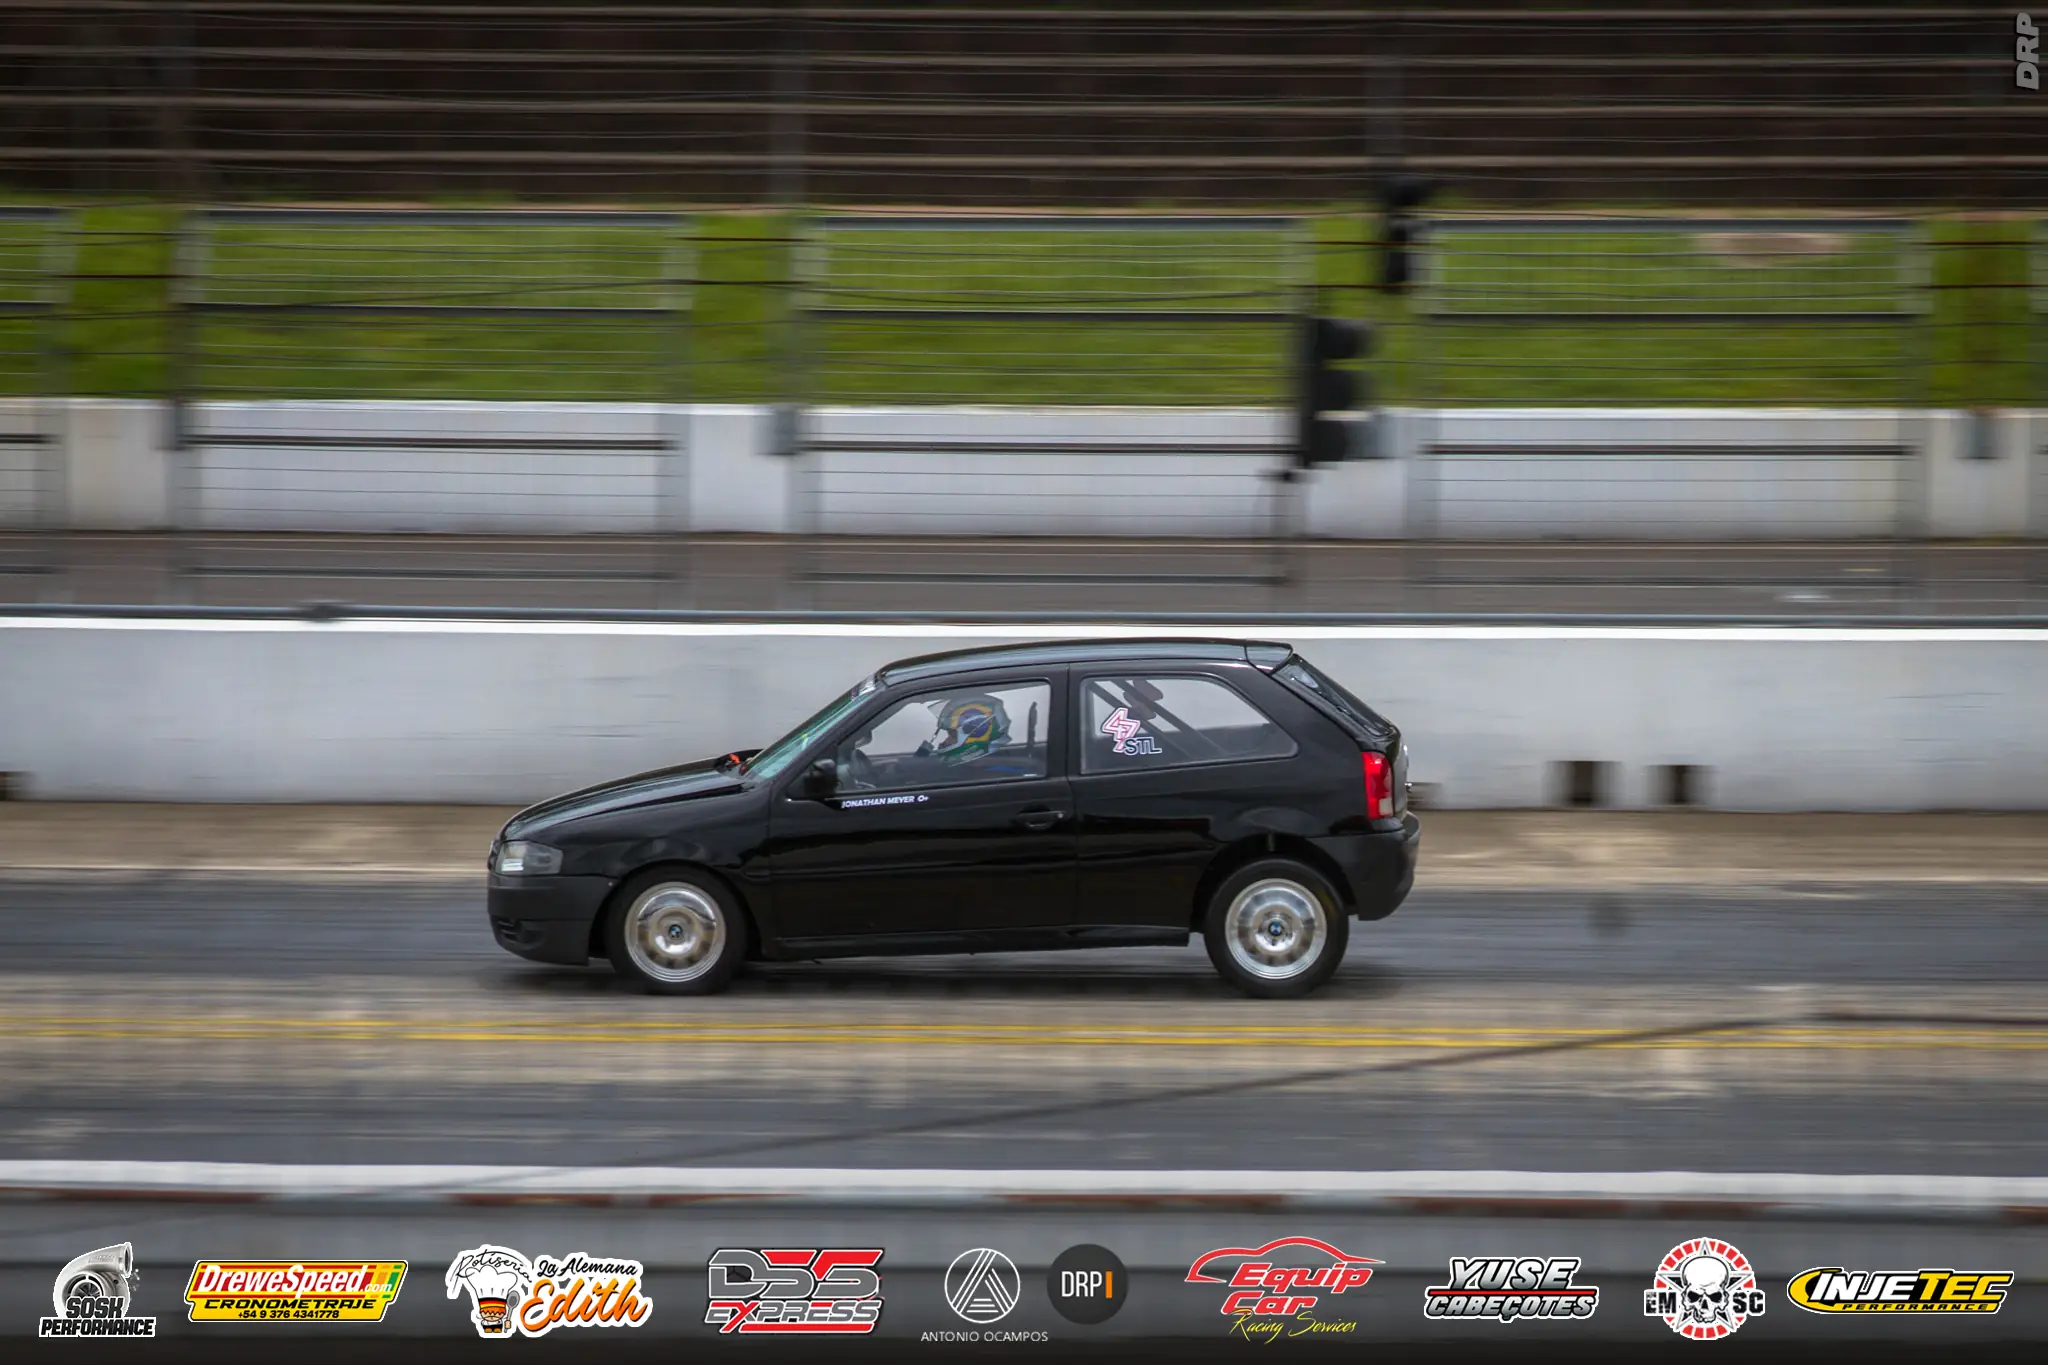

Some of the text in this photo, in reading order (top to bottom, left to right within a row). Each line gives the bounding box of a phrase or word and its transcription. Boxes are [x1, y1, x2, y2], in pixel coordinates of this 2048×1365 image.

[1124, 737, 1162, 755] STL
[841, 798, 886, 809] JONATHAN
[887, 795, 915, 804] MEYER
